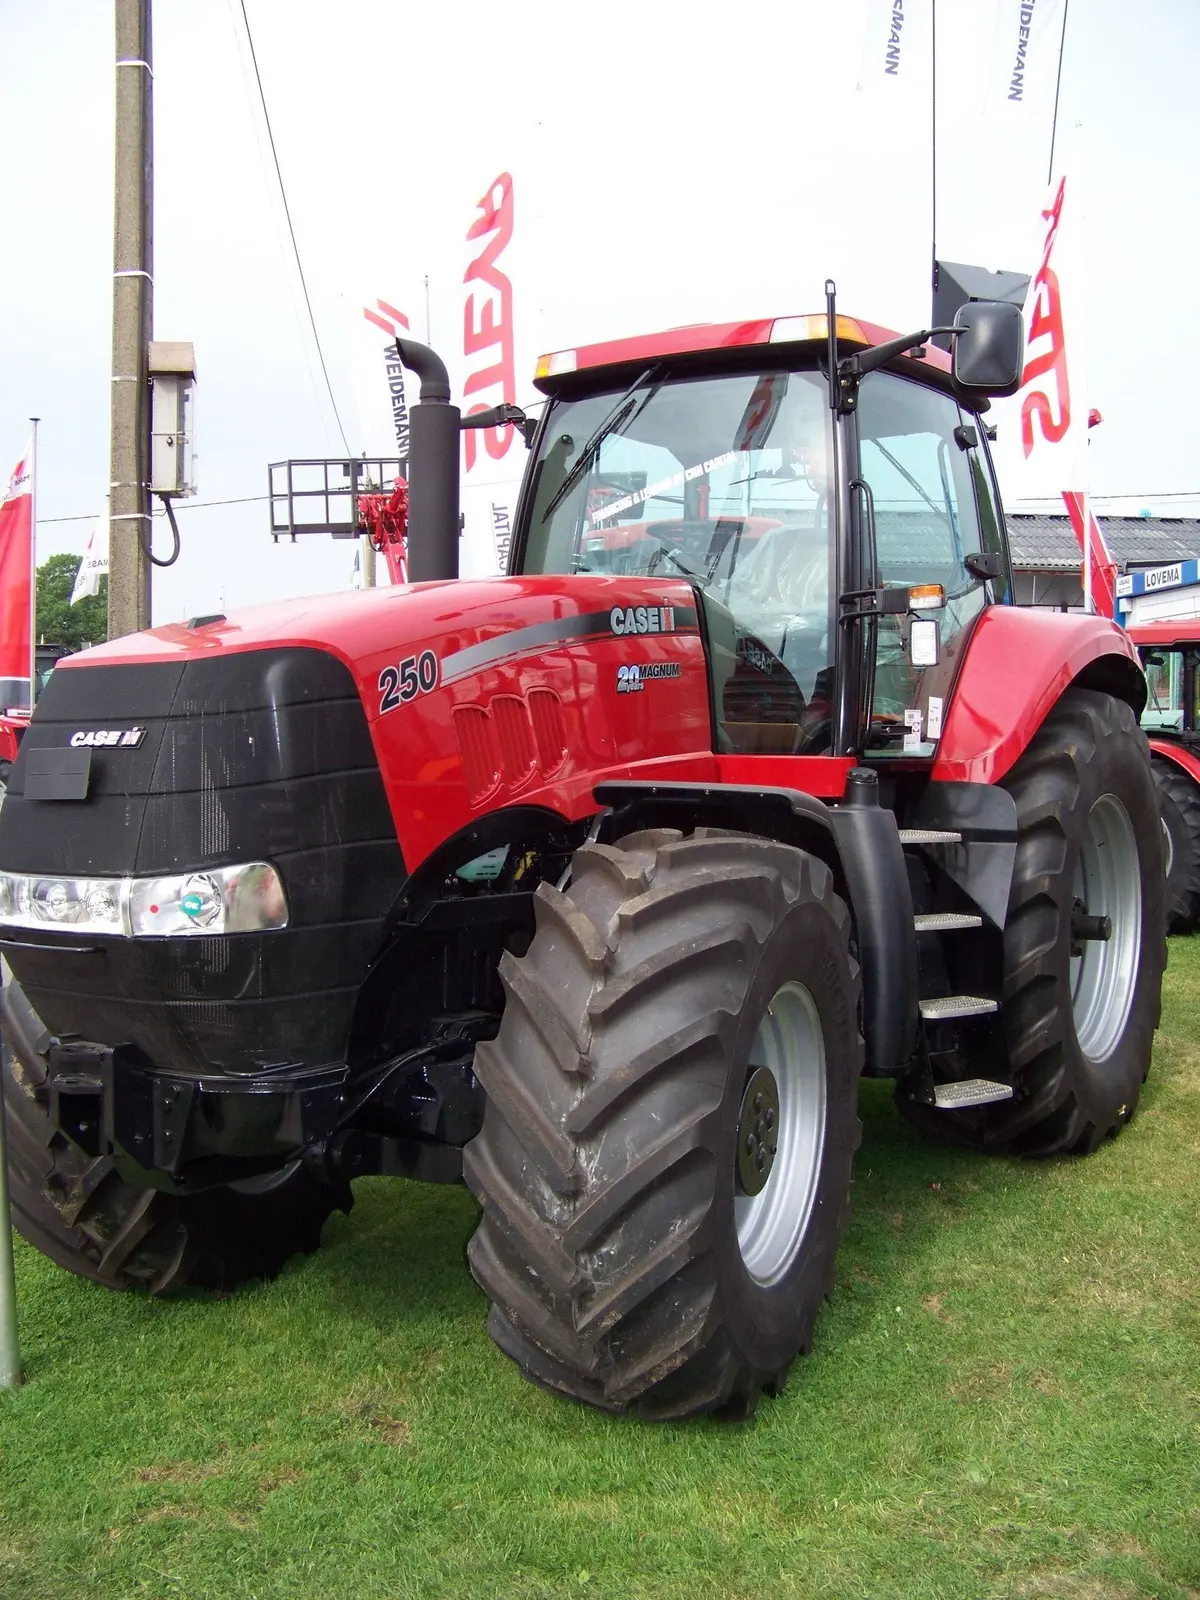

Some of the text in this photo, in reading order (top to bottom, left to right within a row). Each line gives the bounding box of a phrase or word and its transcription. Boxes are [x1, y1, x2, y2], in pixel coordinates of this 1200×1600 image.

[1146, 567, 1180, 588] LOVEMA
[610, 606, 659, 634] CASE
[378, 649, 441, 714] 250
[616, 663, 680, 692] 20 MAGNUM
[70, 731, 121, 747] CASE
[184, 901, 199, 910] OK
